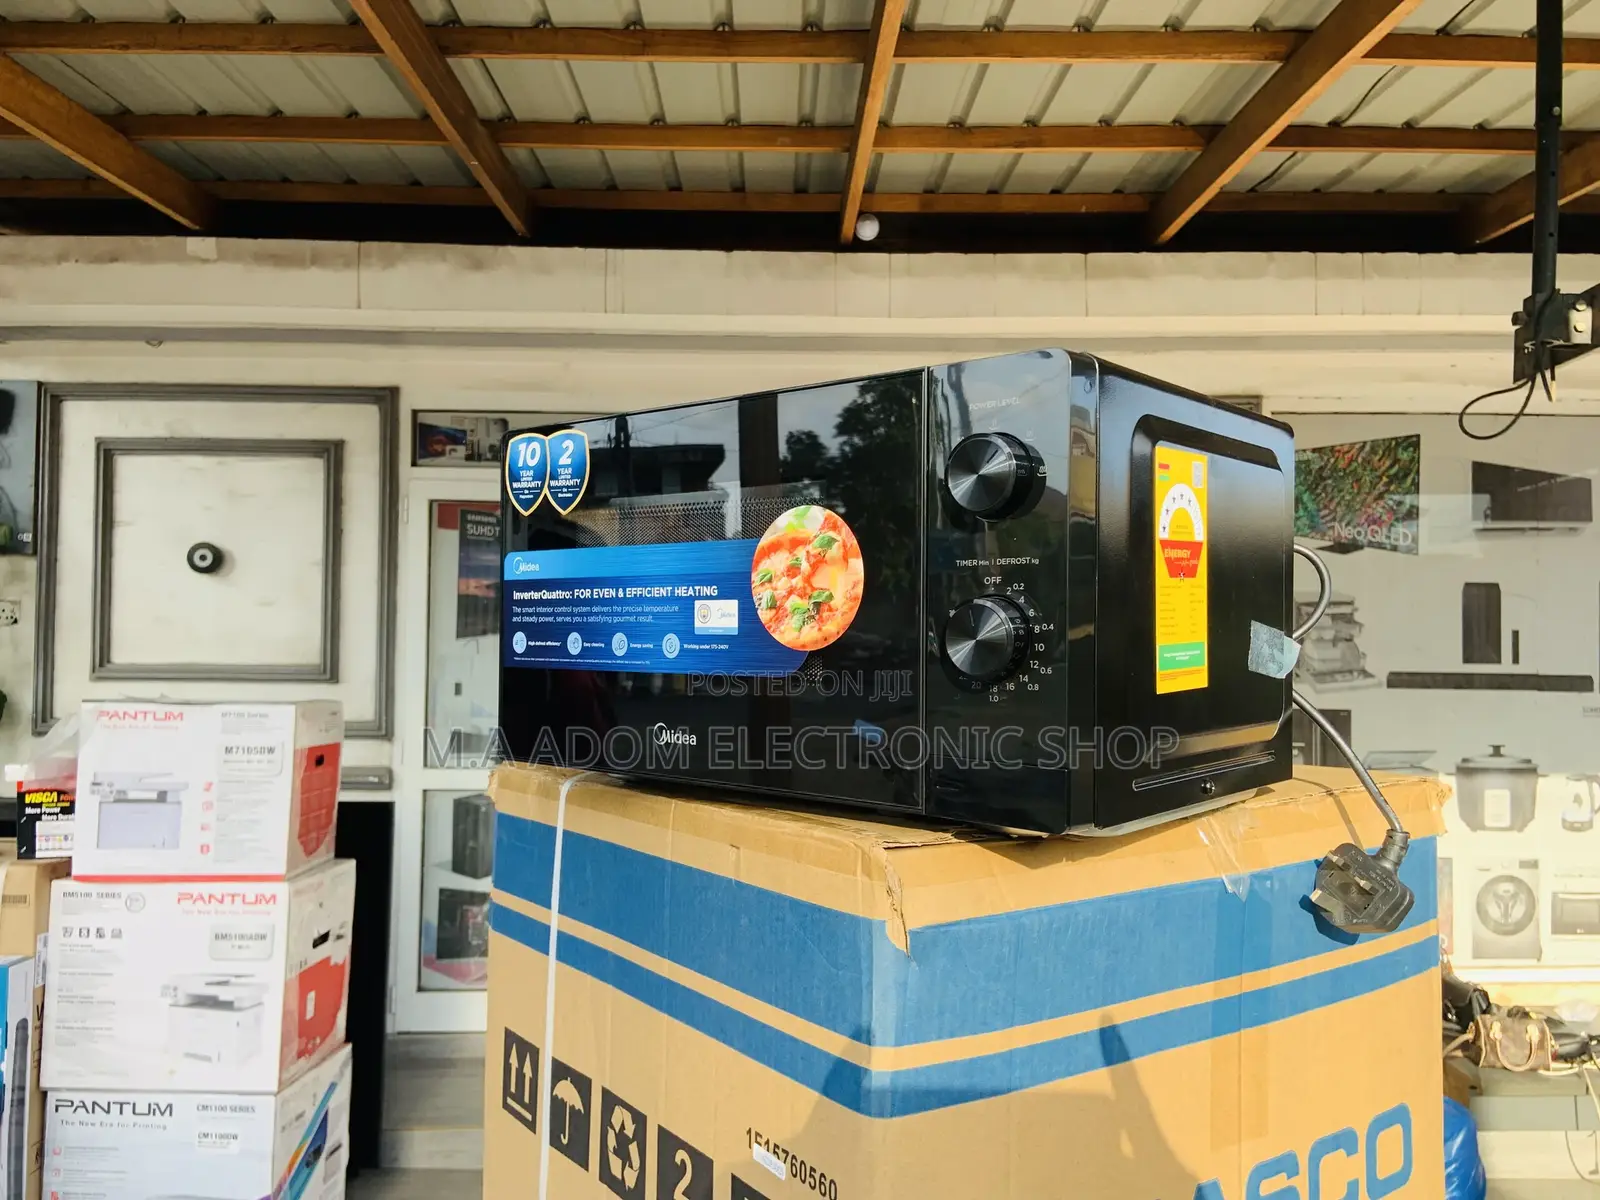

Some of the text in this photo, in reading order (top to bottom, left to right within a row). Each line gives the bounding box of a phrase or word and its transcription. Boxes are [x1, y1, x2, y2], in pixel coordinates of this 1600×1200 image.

[969, 400, 996, 410] POWER
[518, 441, 541, 467] 10
[558, 439, 575, 465] 2
[466, 523, 494, 536] SUHD
[1332, 522, 1412, 547] Neo QLED
[513, 556, 540, 574] Midea
[996, 557, 1031, 565] DEFROST
[513, 585, 718, 599] InverterQuattro: FOR EVEN & EFFICIENT HEATING
[622, 605, 642, 613] precise
[644, 605, 679, 613] temperature
[522, 615, 537, 623] steady
[587, 615, 611, 623] satisfying
[613, 615, 636, 623] gourmet
[1034, 623, 1054, 633] 8 0.4
[1035, 643, 1045, 651] 10
[1030, 660, 1039, 668] 12
[1040, 666, 1052, 674] 0.6
[1019, 674, 1029, 682] 14
[1006, 682, 1015, 690] 16
[1027, 683, 1039, 691] 0.8
[96, 710, 184, 721] PANTUM
[653, 722, 697, 746] Midea
[25, 791, 58, 804] VISCA
[25, 806, 41, 814] More
[177, 892, 277, 905] PANTUM
[55, 1099, 173, 1117] PANTUM
[133, 1122, 168, 1130] Printing
